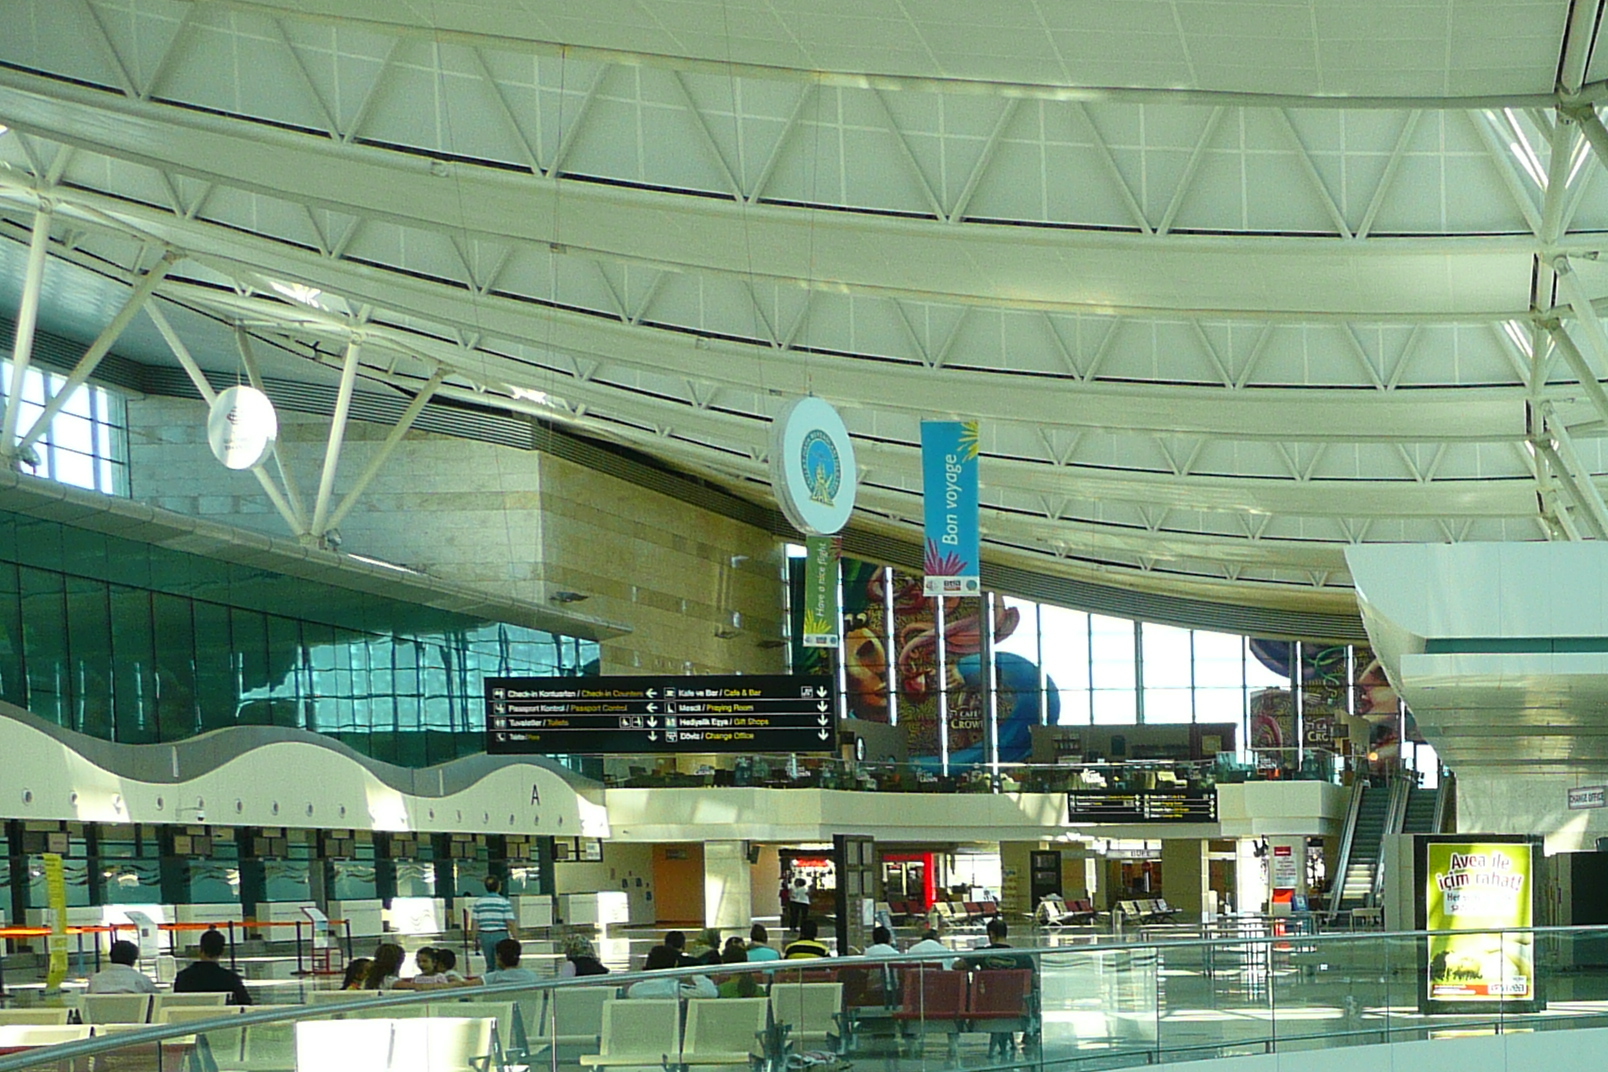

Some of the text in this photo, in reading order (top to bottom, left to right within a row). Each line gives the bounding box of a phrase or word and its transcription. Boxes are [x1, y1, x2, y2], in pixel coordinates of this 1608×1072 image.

[942, 454, 962, 545] Bon voyage
[815, 594, 825, 617] Have
[508, 690, 537, 698] Check-in
[678, 689, 695, 697] Kafe
[705, 689, 719, 697] Bar
[724, 688, 740, 696] Cafe
[571, 705, 601, 713] Passport
[707, 704, 732, 712] Praying
[748, 718, 769, 726] Shops
[705, 732, 733, 740] Change
[531, 784, 540, 805] A
[1452, 853, 1510, 870] Avea ile
[1437, 871, 1522, 891] içim rahat!
